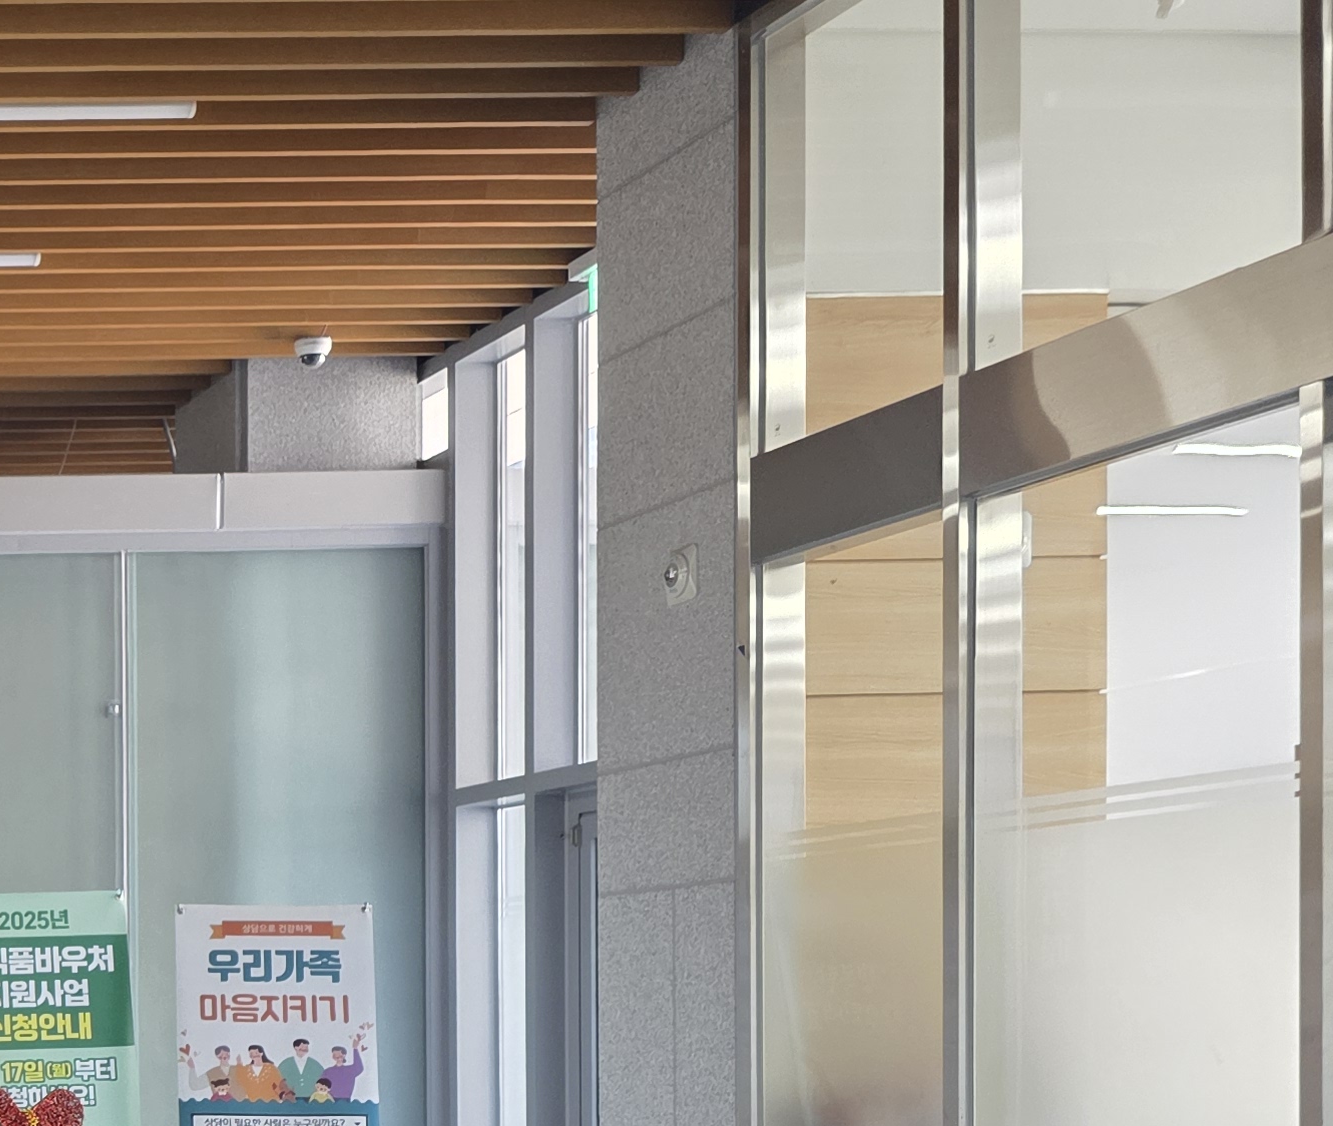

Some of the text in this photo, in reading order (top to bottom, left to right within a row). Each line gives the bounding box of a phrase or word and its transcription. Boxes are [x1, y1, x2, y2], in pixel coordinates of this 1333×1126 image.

[242, 924, 313, 934] 상담으로 건강하게
[207, 950, 342, 983] 우리가족
[199, 994, 350, 1024] 마음지키기
[74, 1057, 117, 1080] 부터
